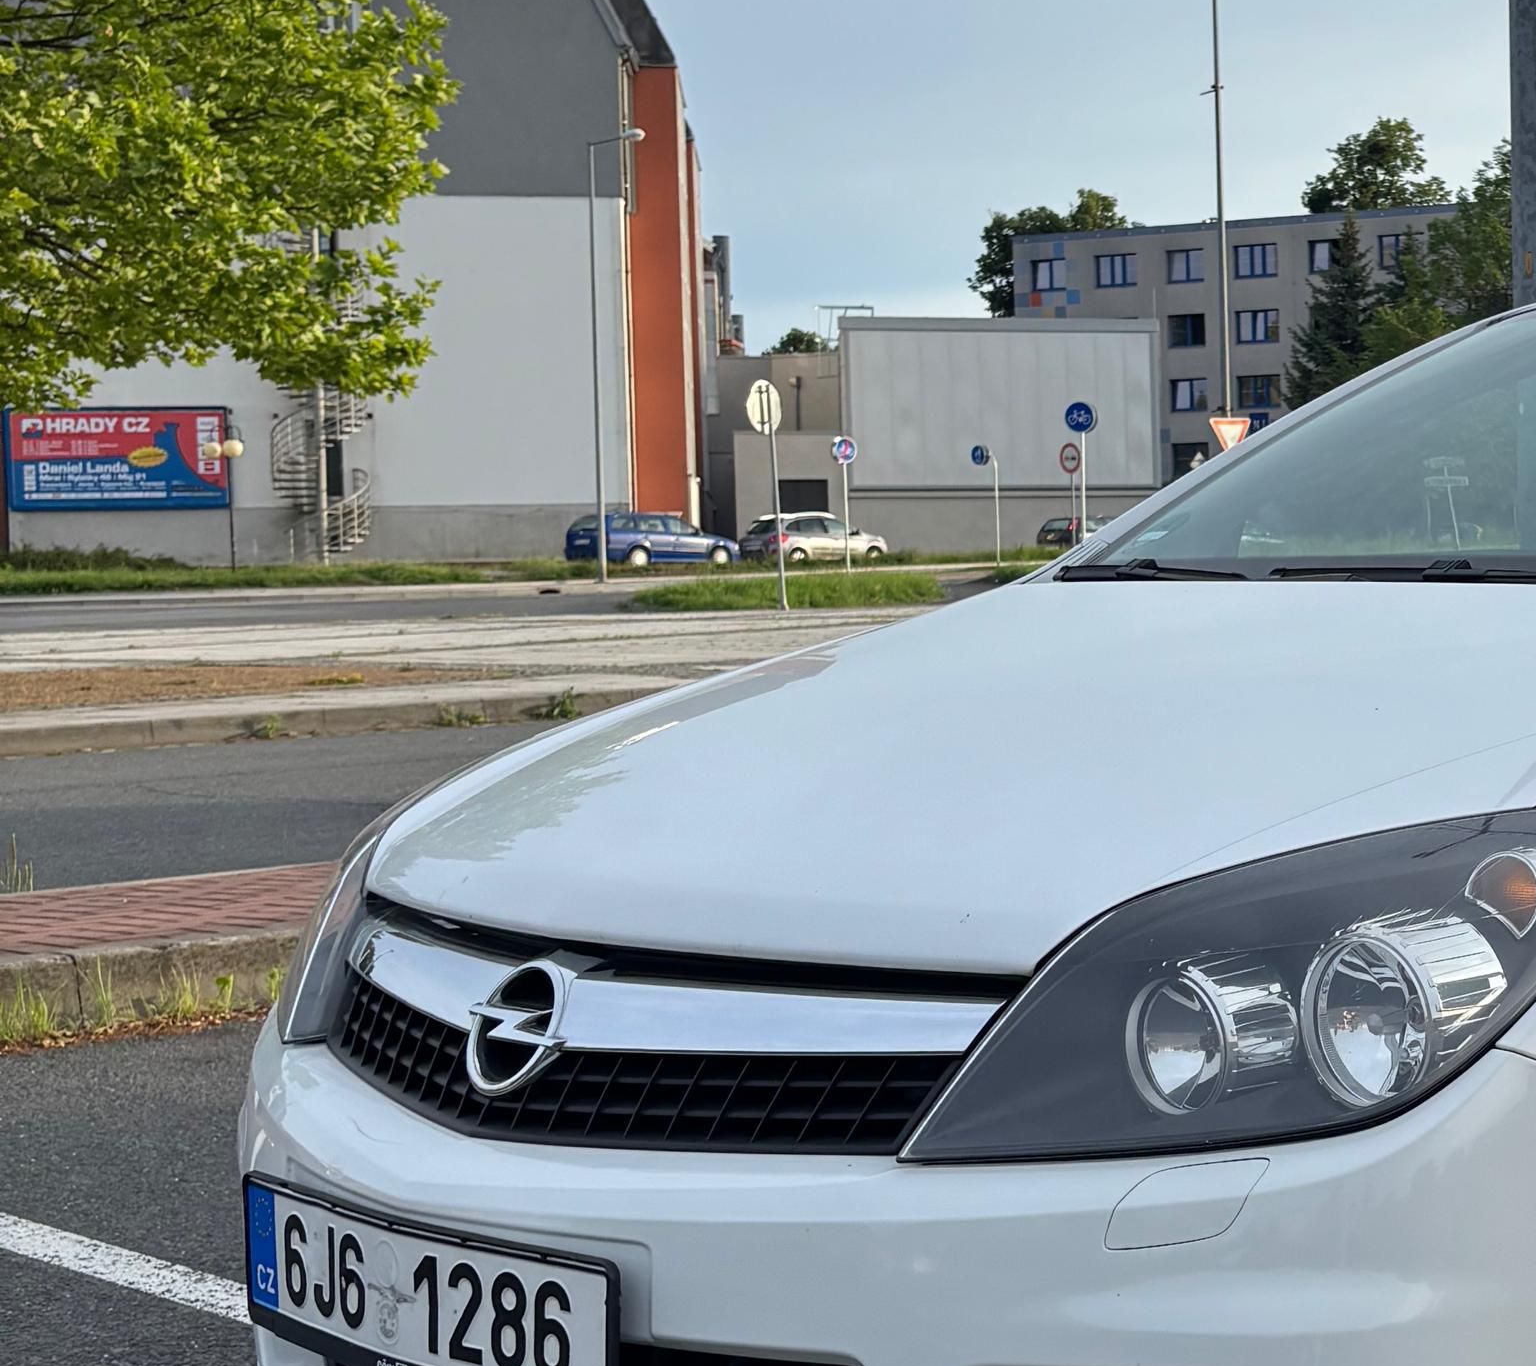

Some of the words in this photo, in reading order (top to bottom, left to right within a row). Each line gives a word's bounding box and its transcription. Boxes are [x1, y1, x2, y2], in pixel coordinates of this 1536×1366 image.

[46, 417, 118, 434] HRADY
[122, 416, 151, 433] CZ
[38, 461, 83, 474] Daniel
[86, 461, 129, 474] Landa
[257, 1263, 276, 1295] CZ
[284, 1213, 366, 1330] 6J6
